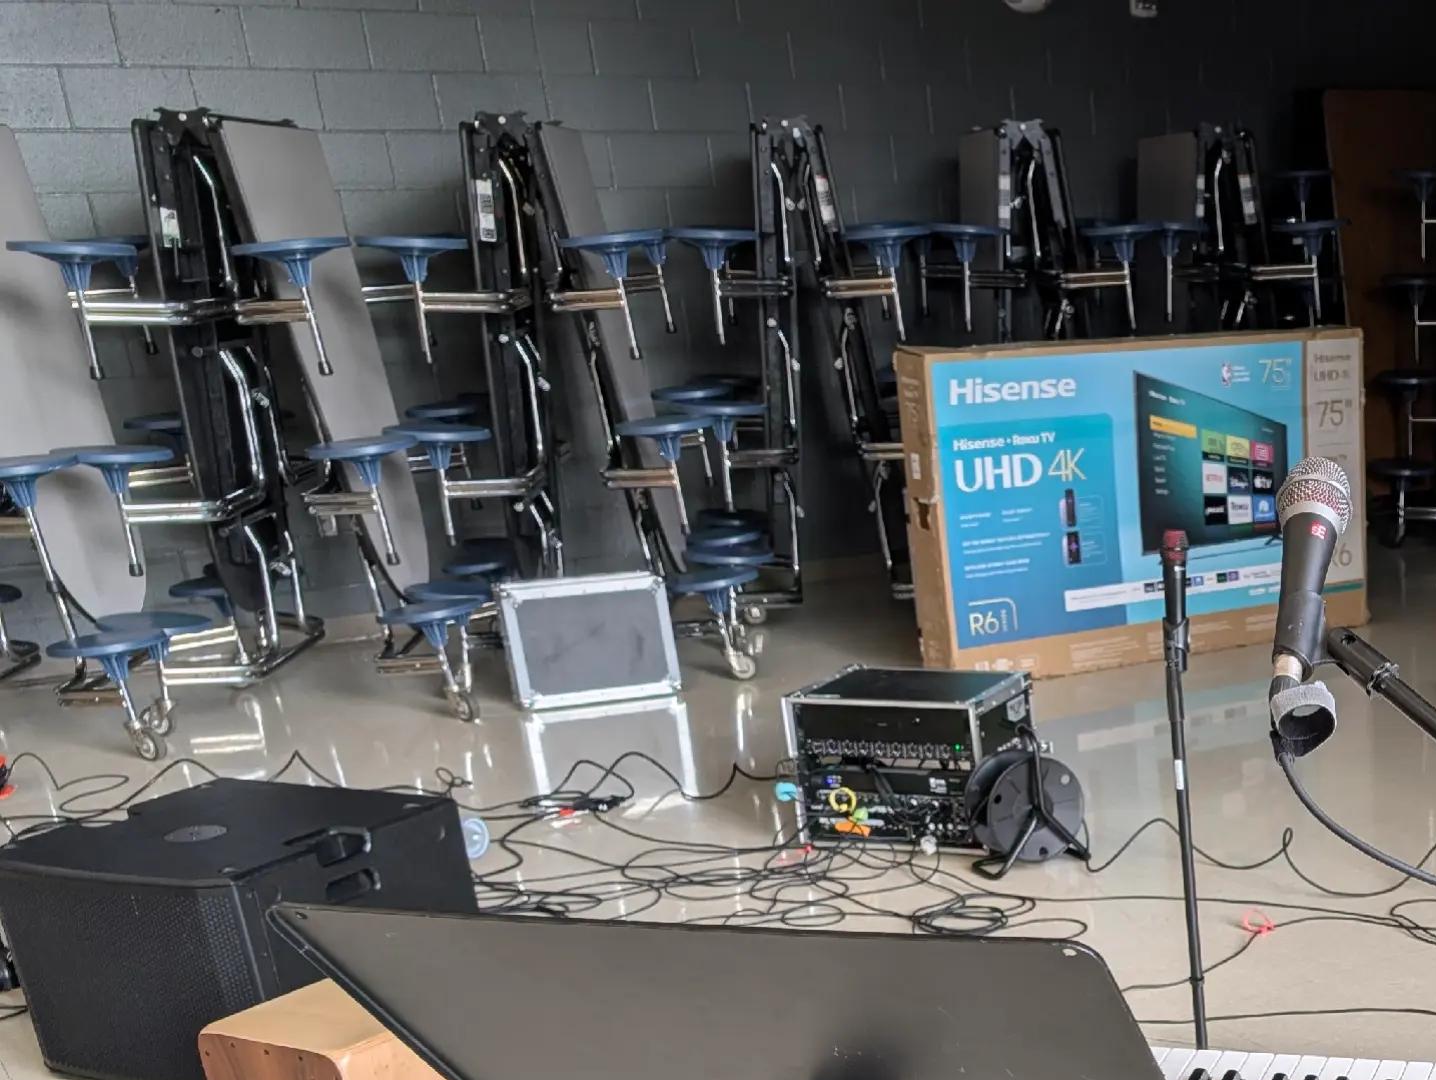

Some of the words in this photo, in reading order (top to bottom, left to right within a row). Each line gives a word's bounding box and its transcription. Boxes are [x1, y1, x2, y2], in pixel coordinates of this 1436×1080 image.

[949, 377, 1077, 406] Hisense
[953, 436, 1005, 451] Hisense
[1040, 431, 1056, 443] TV
[954, 452, 1043, 493] UHD
[1047, 447, 1088, 482] 4K
[968, 610, 1000, 637] R6
